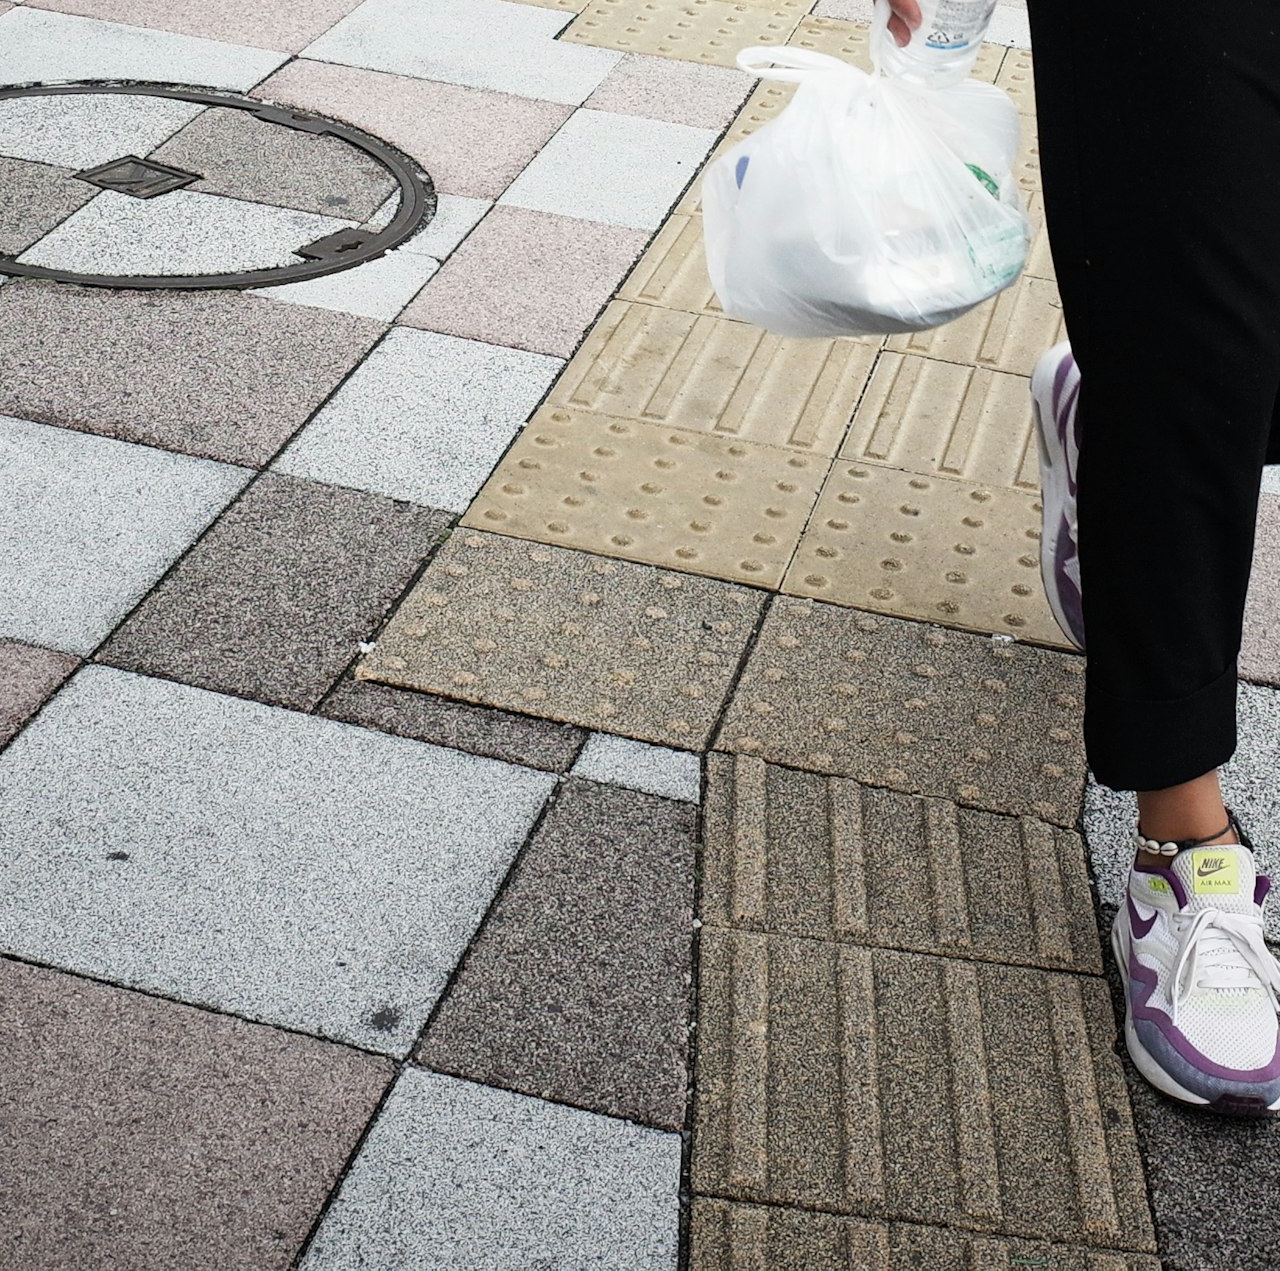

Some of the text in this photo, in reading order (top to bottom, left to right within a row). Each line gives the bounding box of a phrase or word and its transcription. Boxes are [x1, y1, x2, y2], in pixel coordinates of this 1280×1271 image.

[1201, 857, 1225, 870] NIKE
[1200, 879, 1232, 887] AIR MAX
